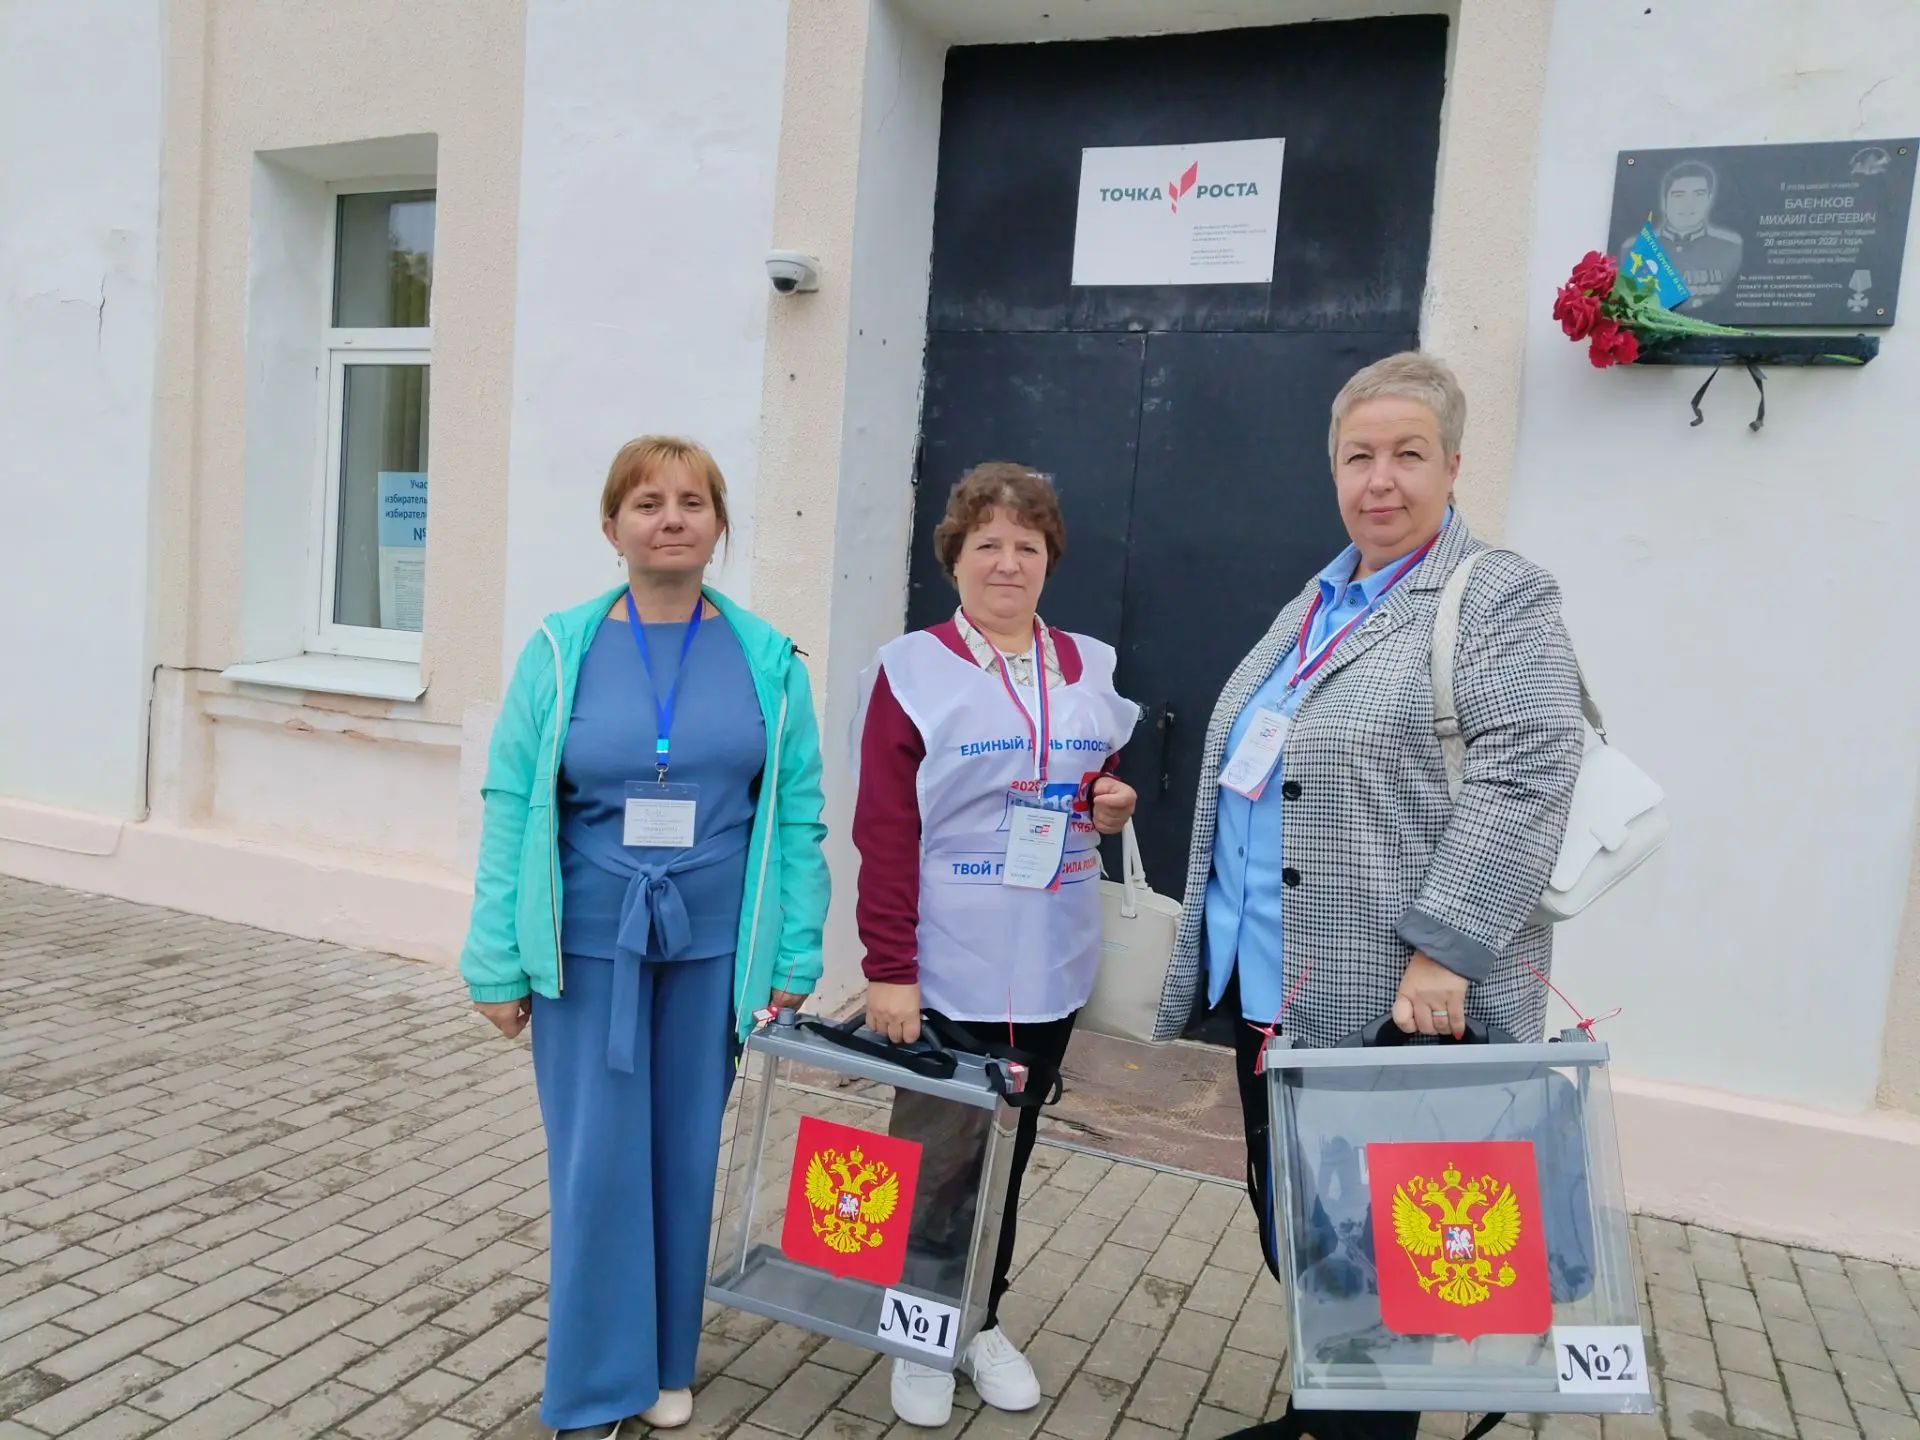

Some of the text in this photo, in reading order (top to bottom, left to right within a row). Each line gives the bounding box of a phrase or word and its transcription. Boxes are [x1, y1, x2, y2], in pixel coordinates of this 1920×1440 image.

[1100, 182, 1259, 202] ТОЧКА РОСТА
[1785, 197, 1855, 209] БАЕНКОВ
[1759, 212, 1876, 225] МИХАИЛ СЕРГЕЕВИЧ
[960, 735, 1024, 756] ЕДИНЫЙ
[952, 860, 991, 875] ТВОЙ
[880, 1297, 951, 1350] №1
[1561, 1343, 1638, 1381] №2
